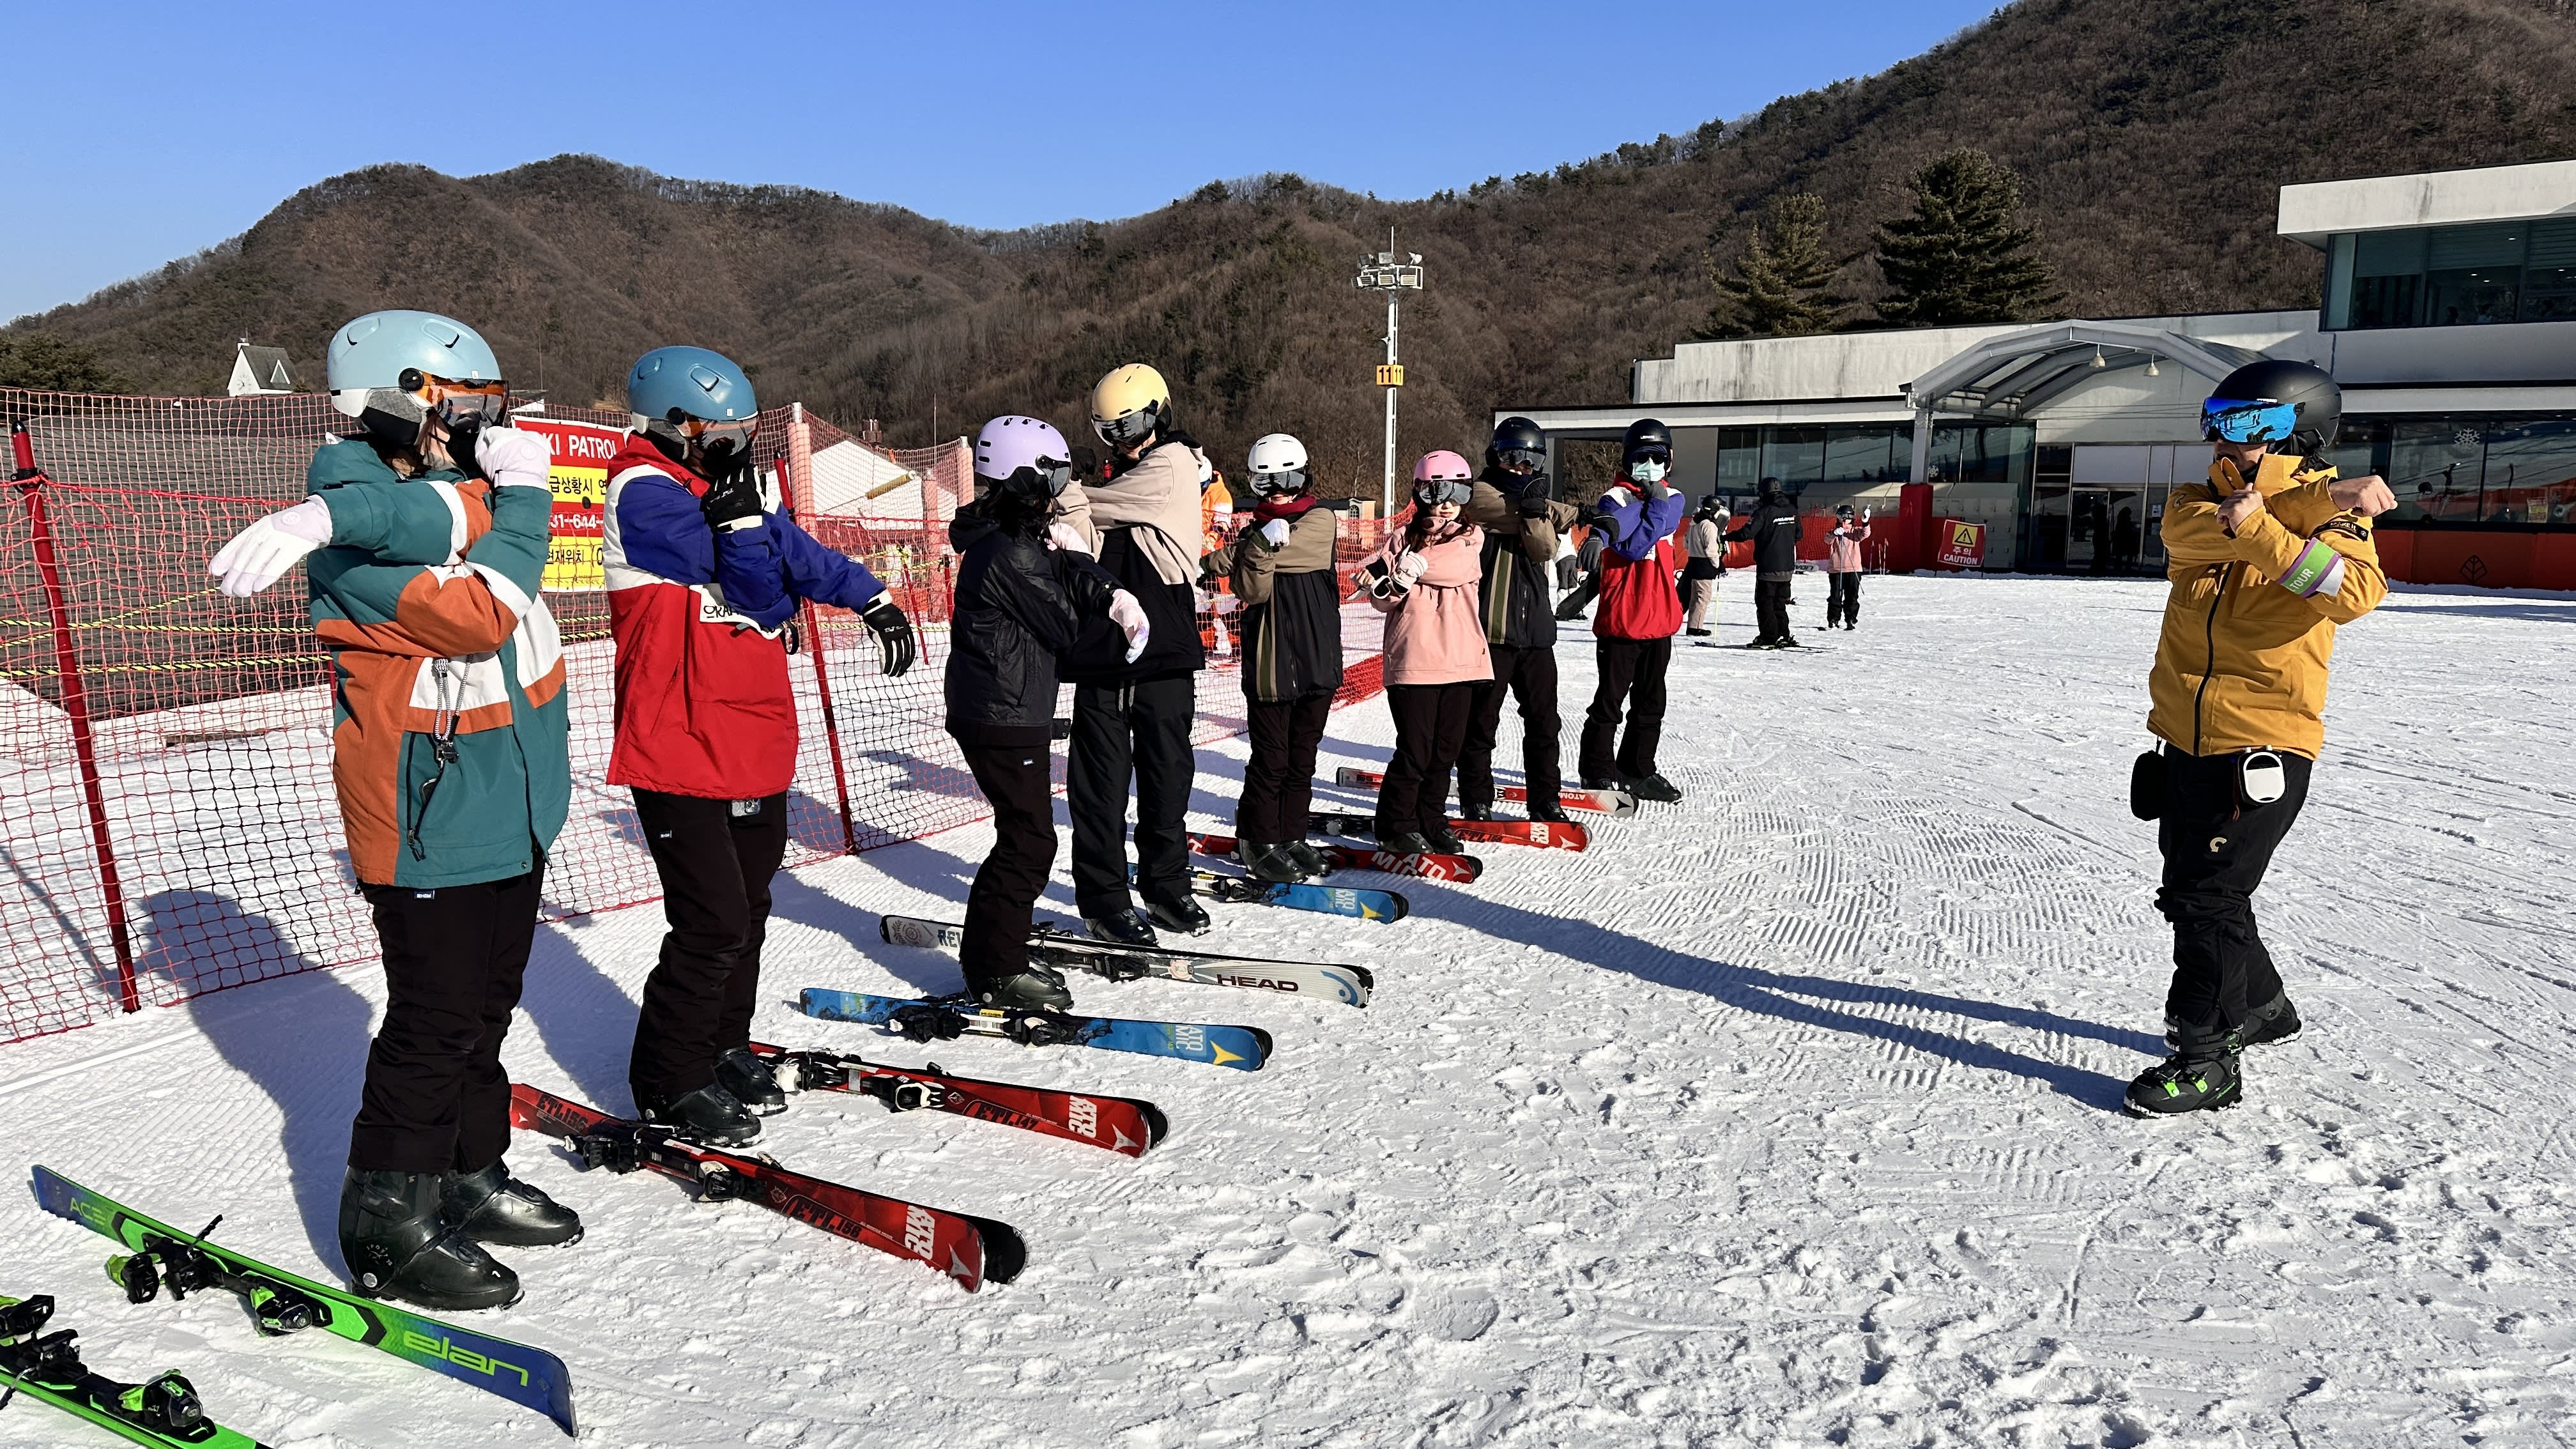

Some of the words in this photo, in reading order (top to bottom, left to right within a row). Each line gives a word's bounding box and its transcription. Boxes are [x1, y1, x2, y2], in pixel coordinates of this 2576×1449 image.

[1379, 367, 1392, 383] 11
[1395, 367, 1402, 383] 11
[542, 433, 560, 456] KI
[549, 475, 592, 496] 급상황시
[598, 479, 607, 496] 연
[549, 514, 603, 529] 31-644-
[1943, 553, 1977, 565] CAUTION
[1952, 546, 1972, 556] 주의
[2289, 568, 2314, 589] TOUR
[1558, 792, 1586, 800] ATOM
[1216, 974, 1299, 992] HEAD
[70, 1197, 107, 1225] ACE
[403, 1330, 529, 1386] elan
